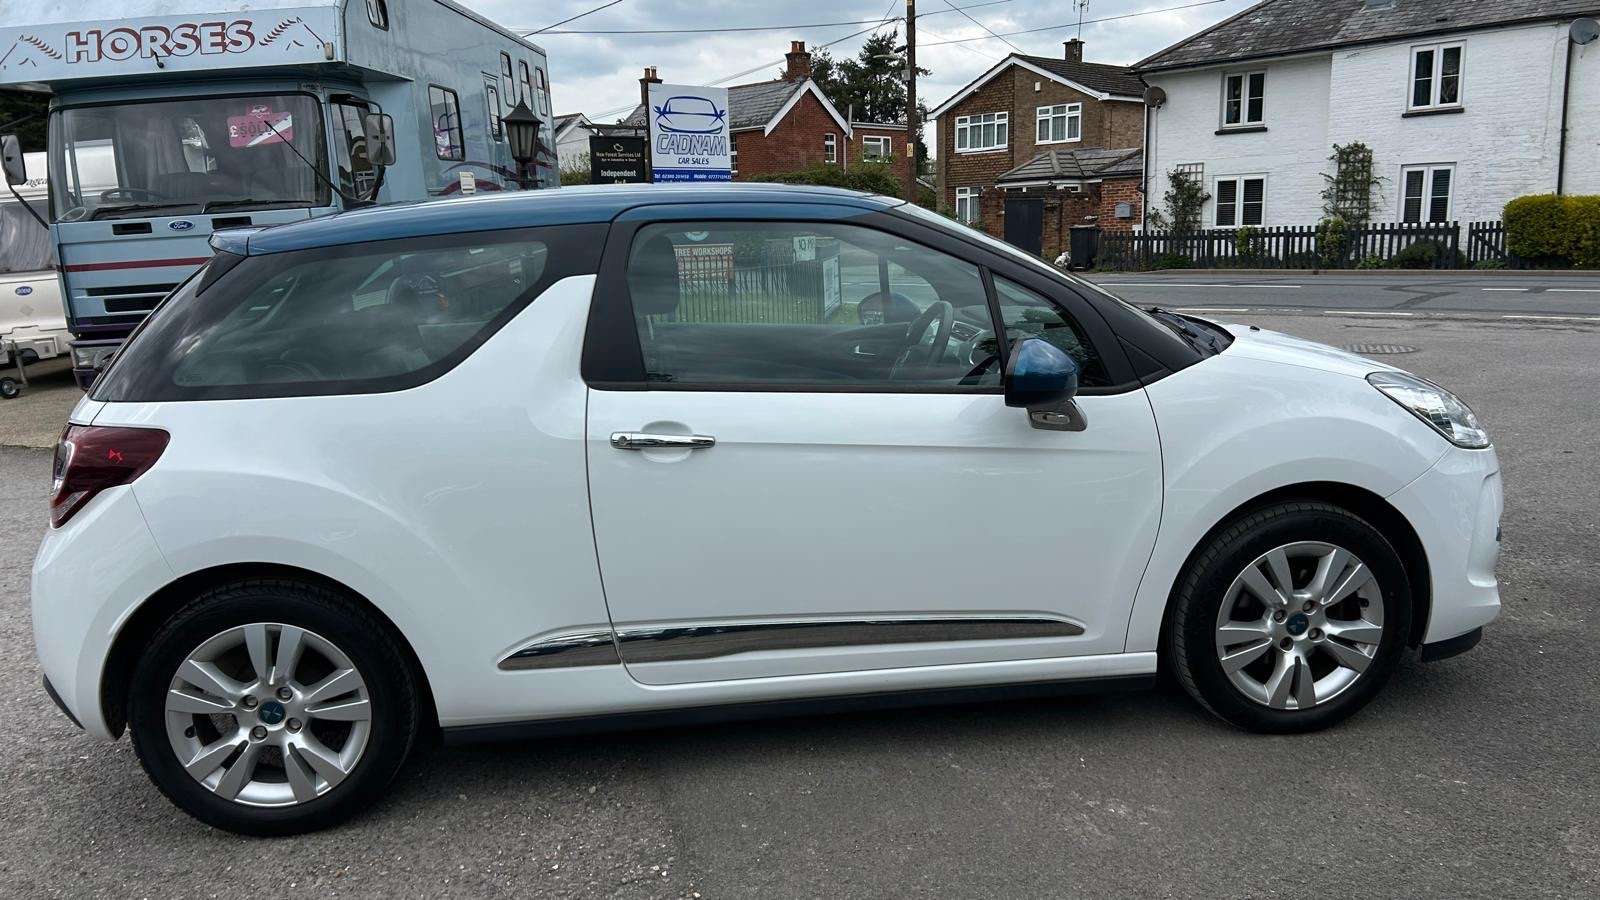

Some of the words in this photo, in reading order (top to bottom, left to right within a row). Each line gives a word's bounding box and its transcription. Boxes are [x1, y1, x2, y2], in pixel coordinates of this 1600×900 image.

[65, 20, 255, 63] HORSES
[656, 133, 727, 156] CADNAM
[678, 157, 690, 165] CAR
[691, 157, 709, 165] SALES
[600, 169, 637, 178] Independent
[674, 248, 691, 256] TREE
[691, 246, 732, 256] WORKSHOPS
